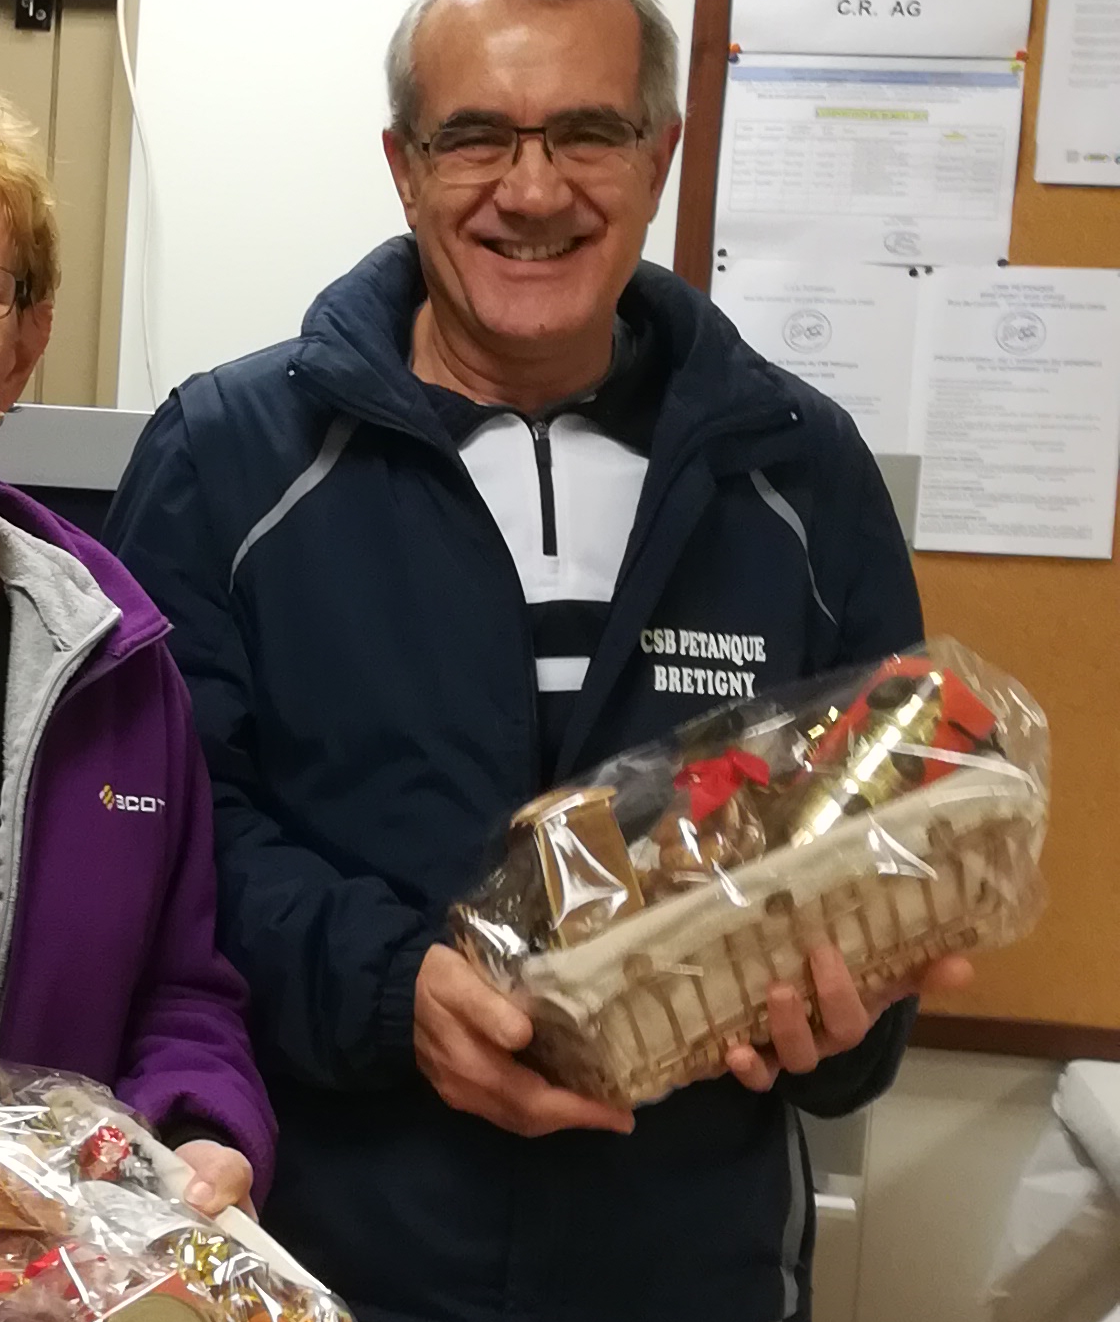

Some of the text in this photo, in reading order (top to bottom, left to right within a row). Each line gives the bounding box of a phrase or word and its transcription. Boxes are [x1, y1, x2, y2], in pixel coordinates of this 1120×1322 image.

[890, 0, 922, 17] AG
[640, 628, 766, 666] CSB PETANQUE
[653, 664, 755, 698] BRETIGNY
